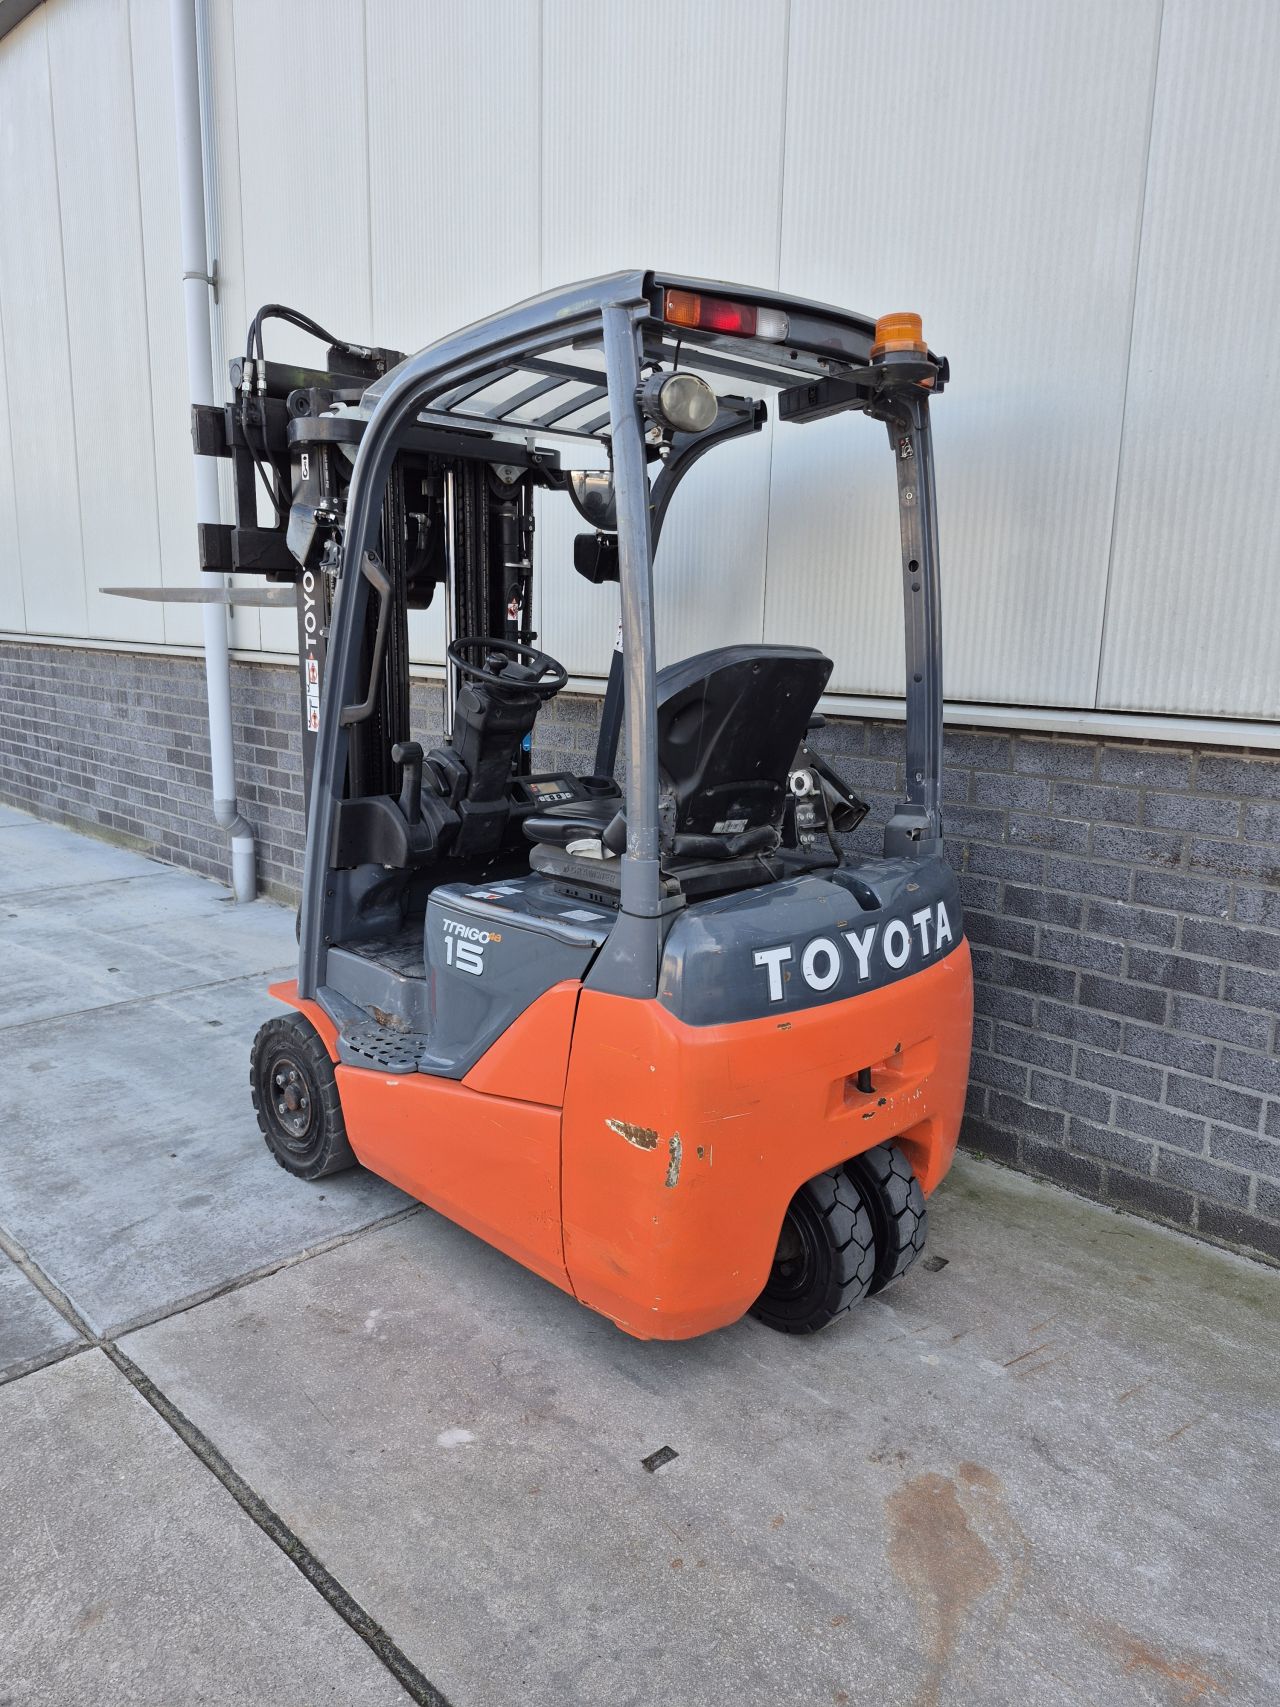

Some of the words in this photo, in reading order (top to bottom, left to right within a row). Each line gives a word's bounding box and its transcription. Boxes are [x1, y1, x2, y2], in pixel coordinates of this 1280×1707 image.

[303, 566, 317, 649] TOYO
[444, 935, 484, 976] 15
[754, 901, 953, 1001] TOYOTA
